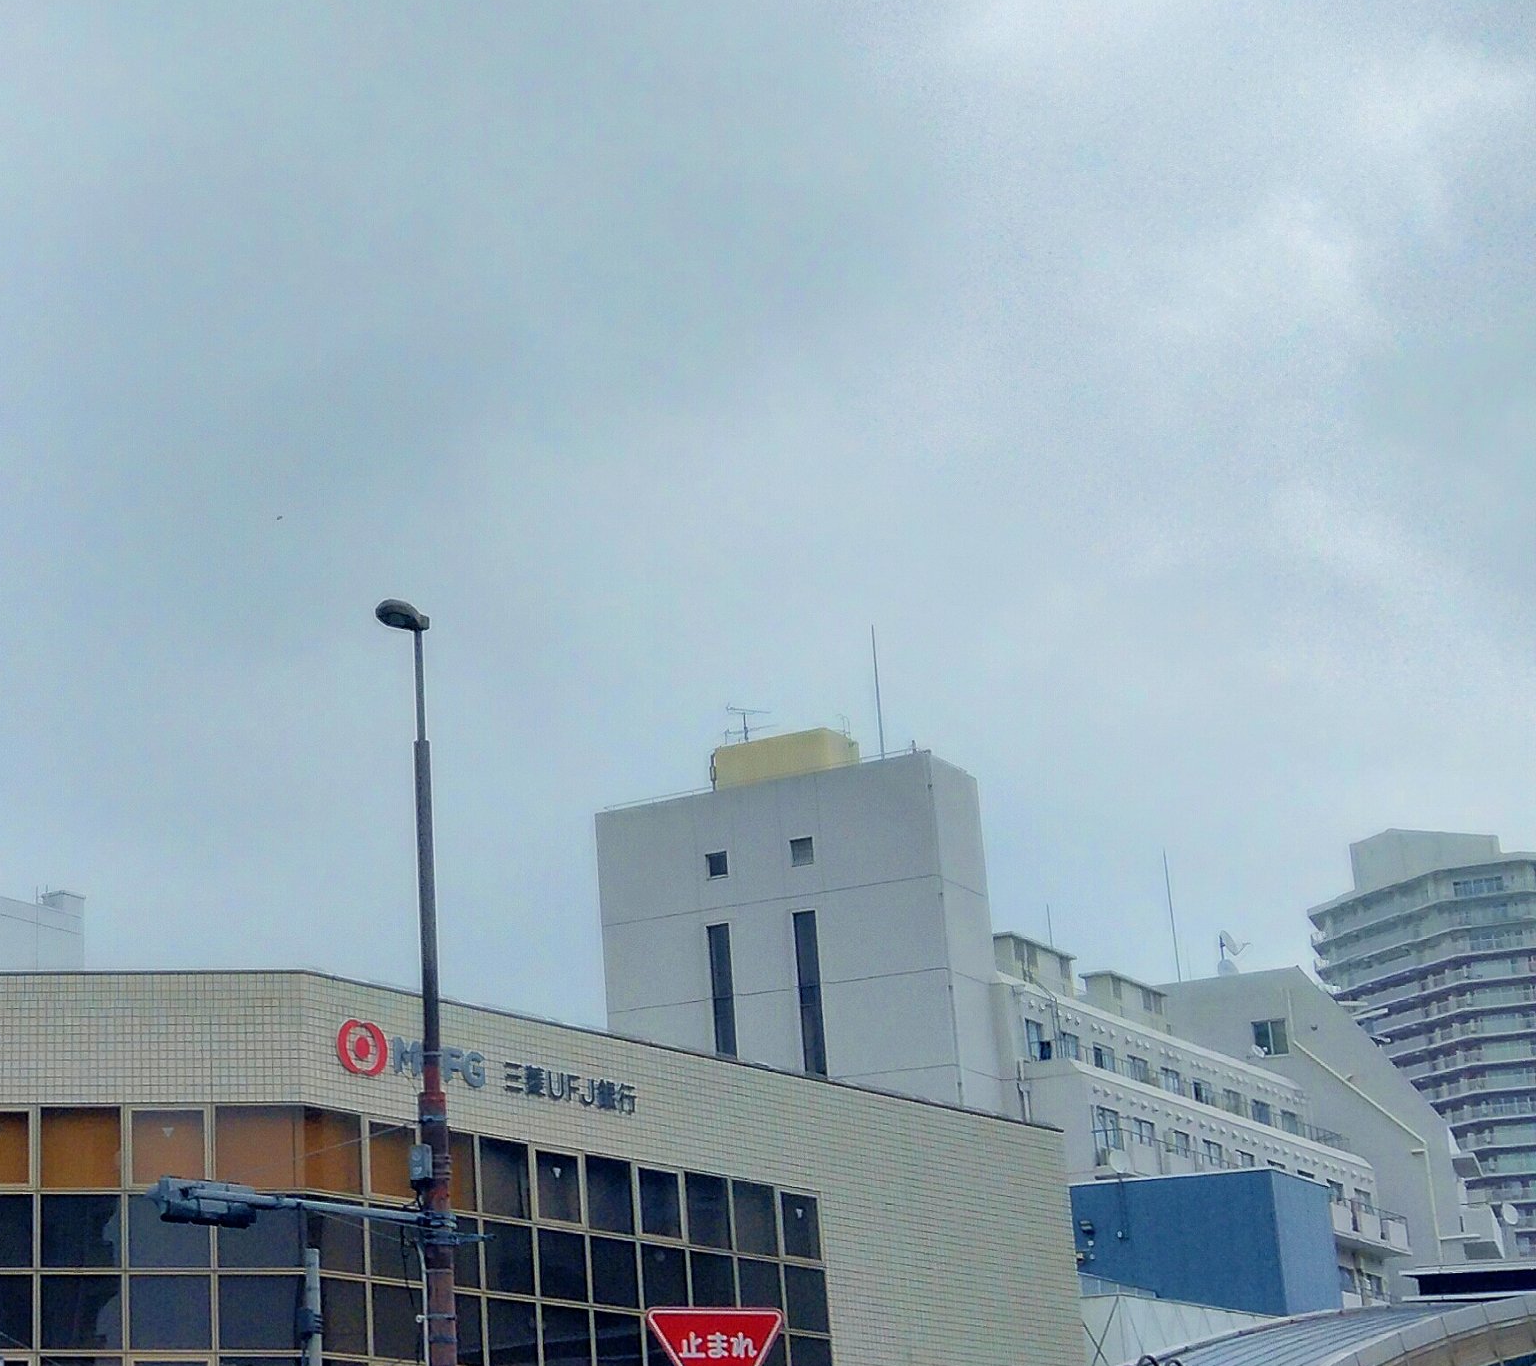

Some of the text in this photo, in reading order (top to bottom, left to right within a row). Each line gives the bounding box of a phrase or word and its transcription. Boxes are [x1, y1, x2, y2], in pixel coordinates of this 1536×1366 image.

[392, 1035, 486, 1088] MFG
[677, 1331, 758, 1358] 止まれ
